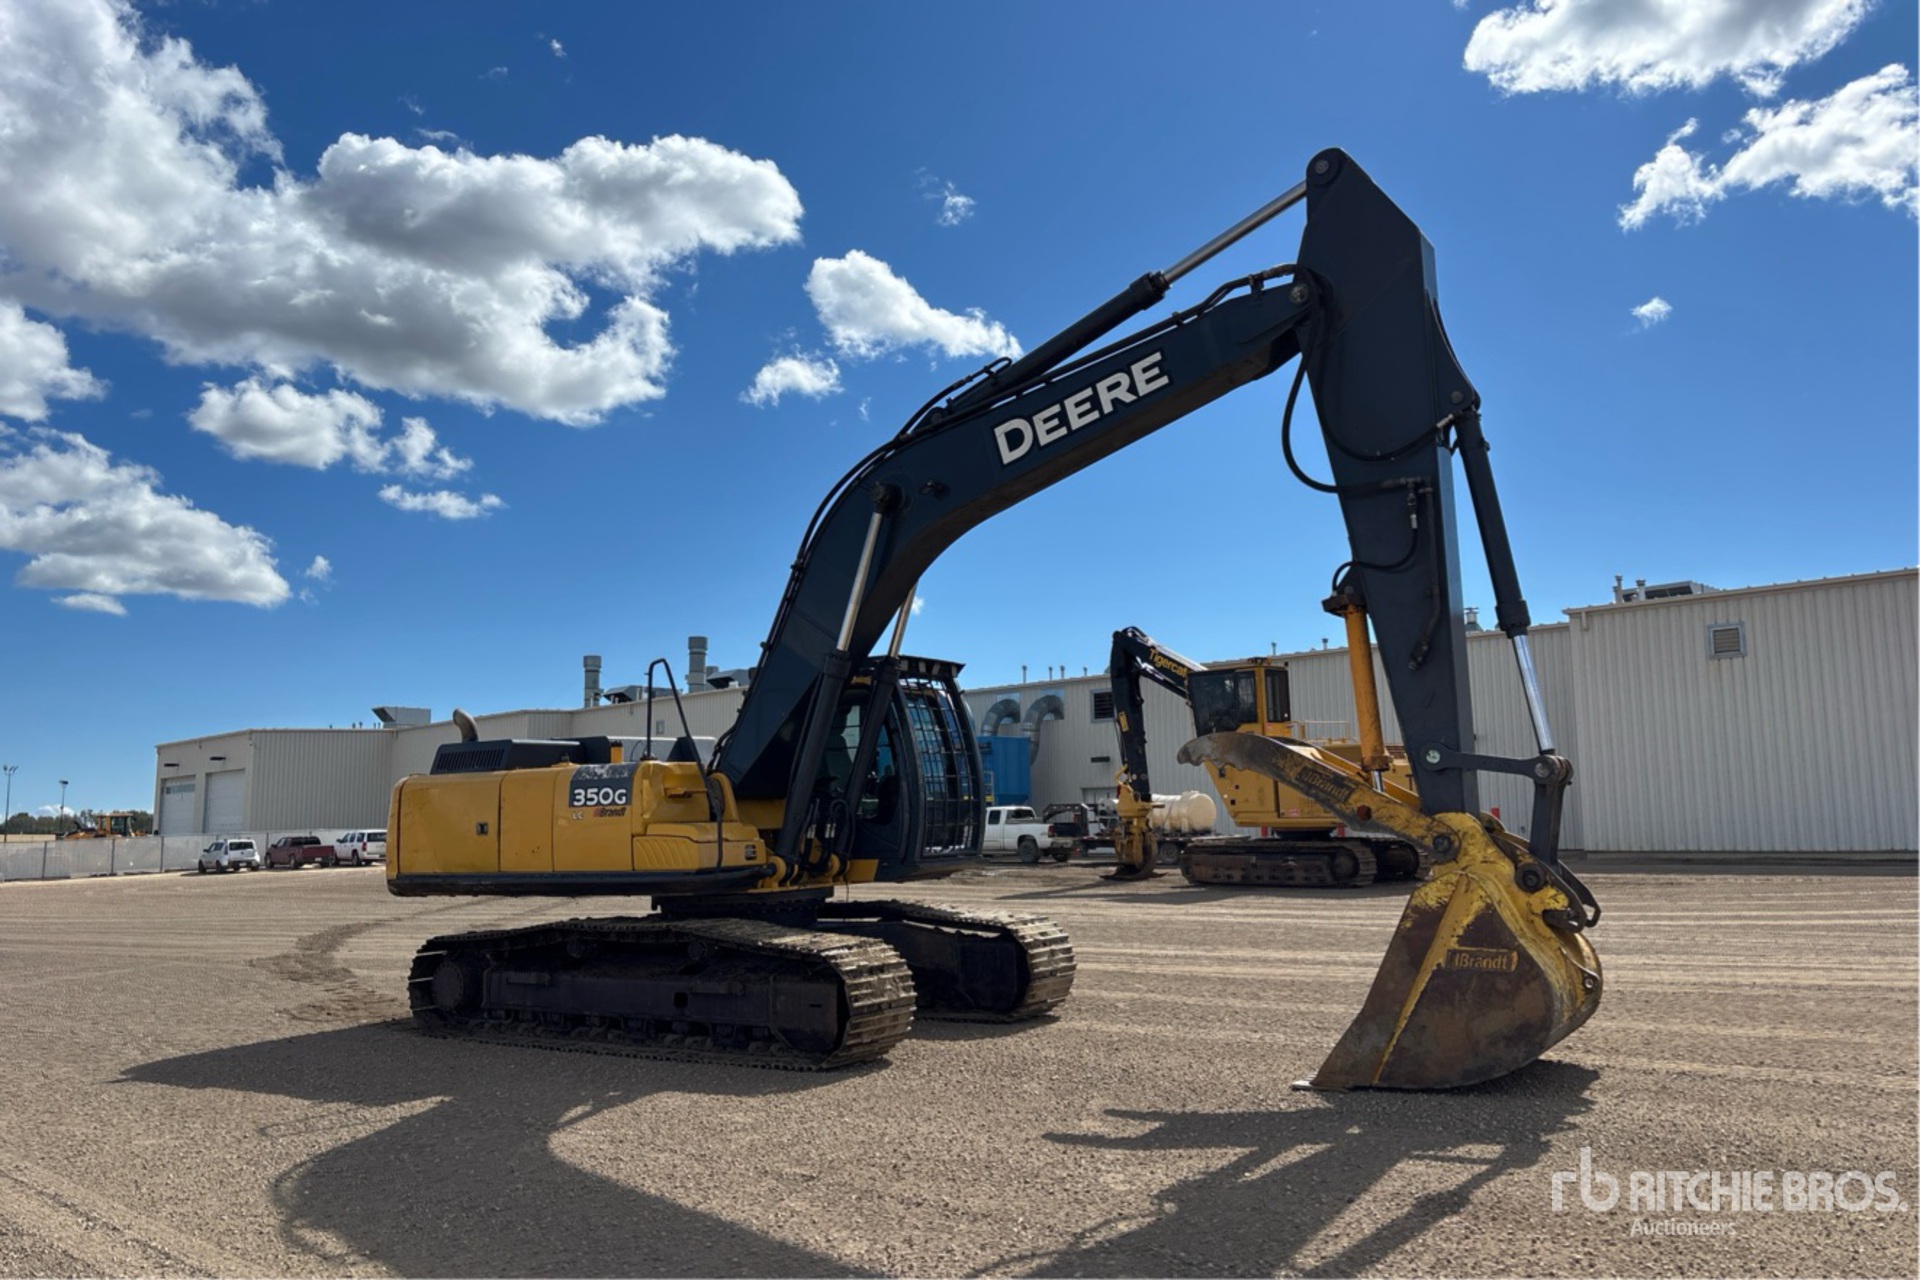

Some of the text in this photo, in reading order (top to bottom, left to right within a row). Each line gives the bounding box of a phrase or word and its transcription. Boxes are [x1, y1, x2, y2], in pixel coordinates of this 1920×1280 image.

[994, 351, 1170, 465] DEERE
[1150, 648, 1187, 677] Tigercat
[573, 787, 627, 806] 350G
